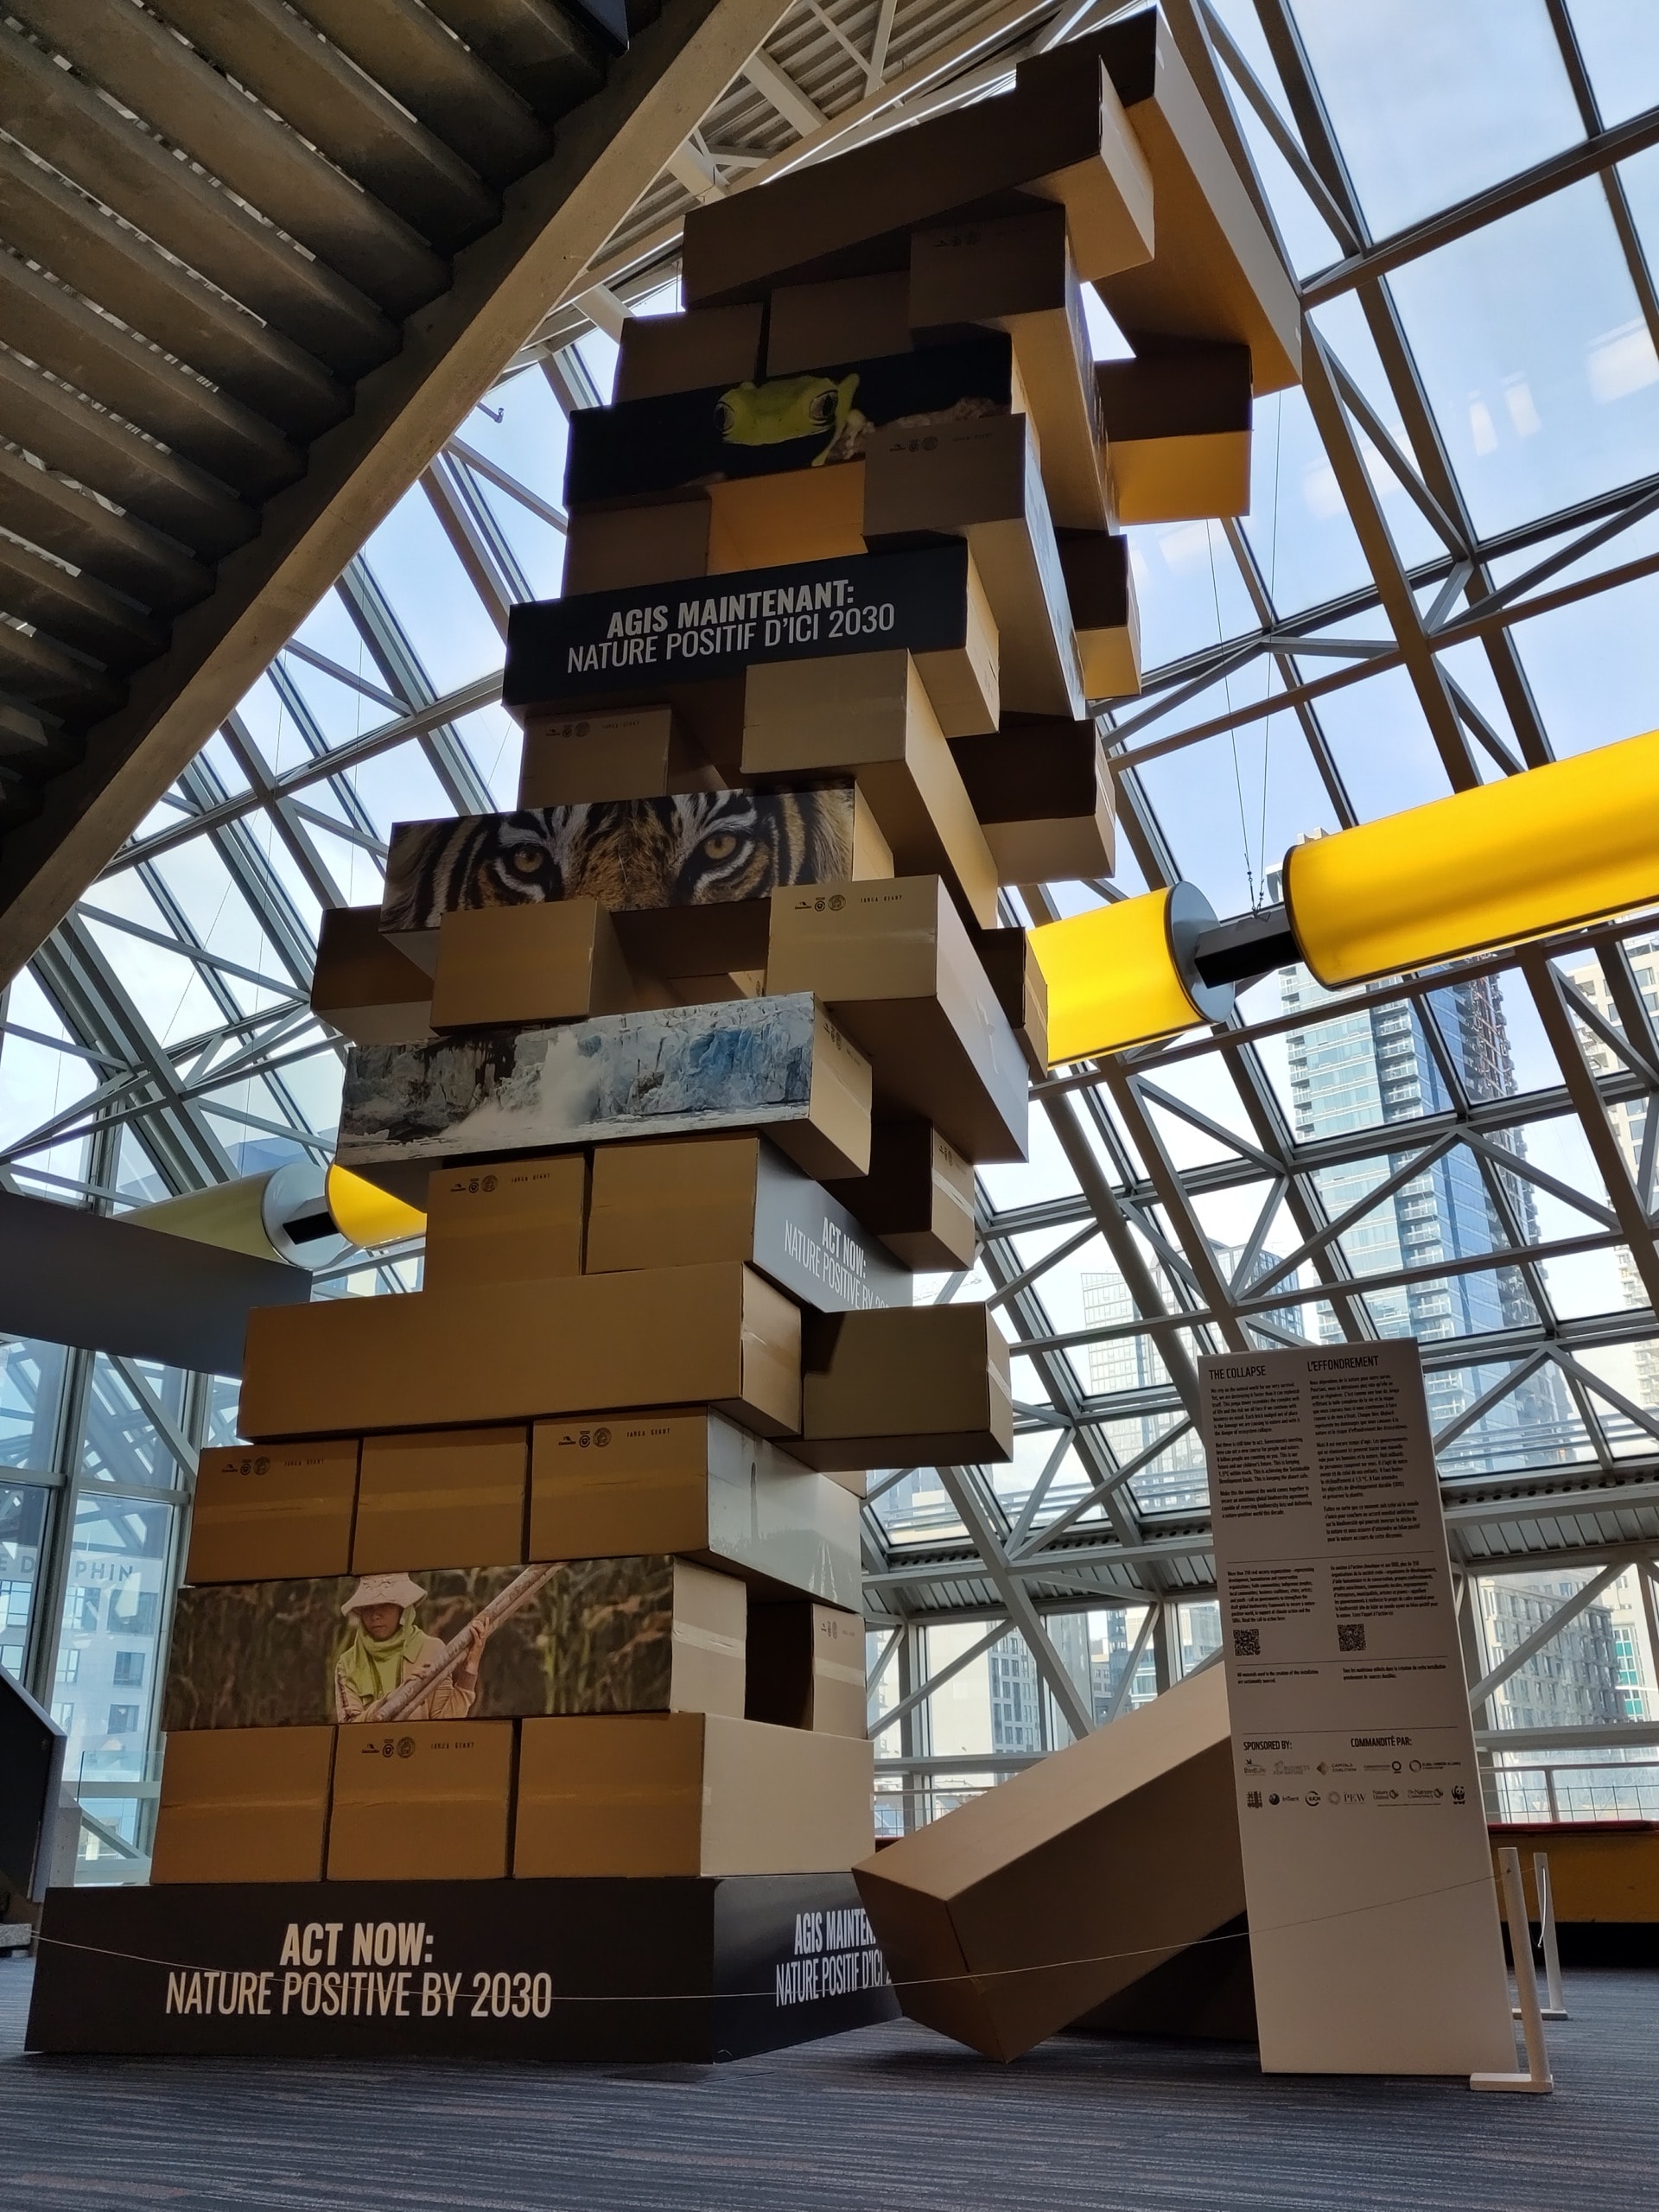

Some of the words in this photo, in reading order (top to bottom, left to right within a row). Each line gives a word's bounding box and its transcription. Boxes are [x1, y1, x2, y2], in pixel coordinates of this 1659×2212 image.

[607, 605, 669, 639] AGIS
[677, 579, 854, 629] MAINTENANT:
[567, 635, 658, 673] NATURE
[666, 622, 757, 660] POSITIF
[765, 613, 819, 647] D'ICI
[829, 602, 895, 639] 2030
[785, 1219, 822, 1279] NATURE
[823, 1252, 861, 1310] POSITIVE
[822, 1216, 842, 1259] ACT
[842, 1233, 867, 1279] NOW:
[1209, 1369, 1224, 1380] THE
[1226, 1365, 1267, 1379] COLLAPSE
[1307, 1355, 1379, 1372] L'EFFONDREMENT
[1243, 1740, 1281, 1751] SPONSORED
[1281, 1740, 1293, 1750] BY:
[1351, 1735, 1395, 1747] COMMANDITÉ
[1396, 1736, 1412, 1746] PAR:
[279, 1923, 344, 1966] ACT
[352, 1922, 434, 1966] NOW:
[794, 1911, 823, 1955] AGIS
[165, 1972, 275, 2015] NATURE
[282, 1972, 412, 2016] POSITIVE
[421, 1972, 462, 2017] BY
[470, 1972, 552, 2018] 2030
[776, 1958, 819, 2007] NATURE
[822, 1952, 860, 1998] POSITIF
[862, 1948, 883, 1989] D'ICI
